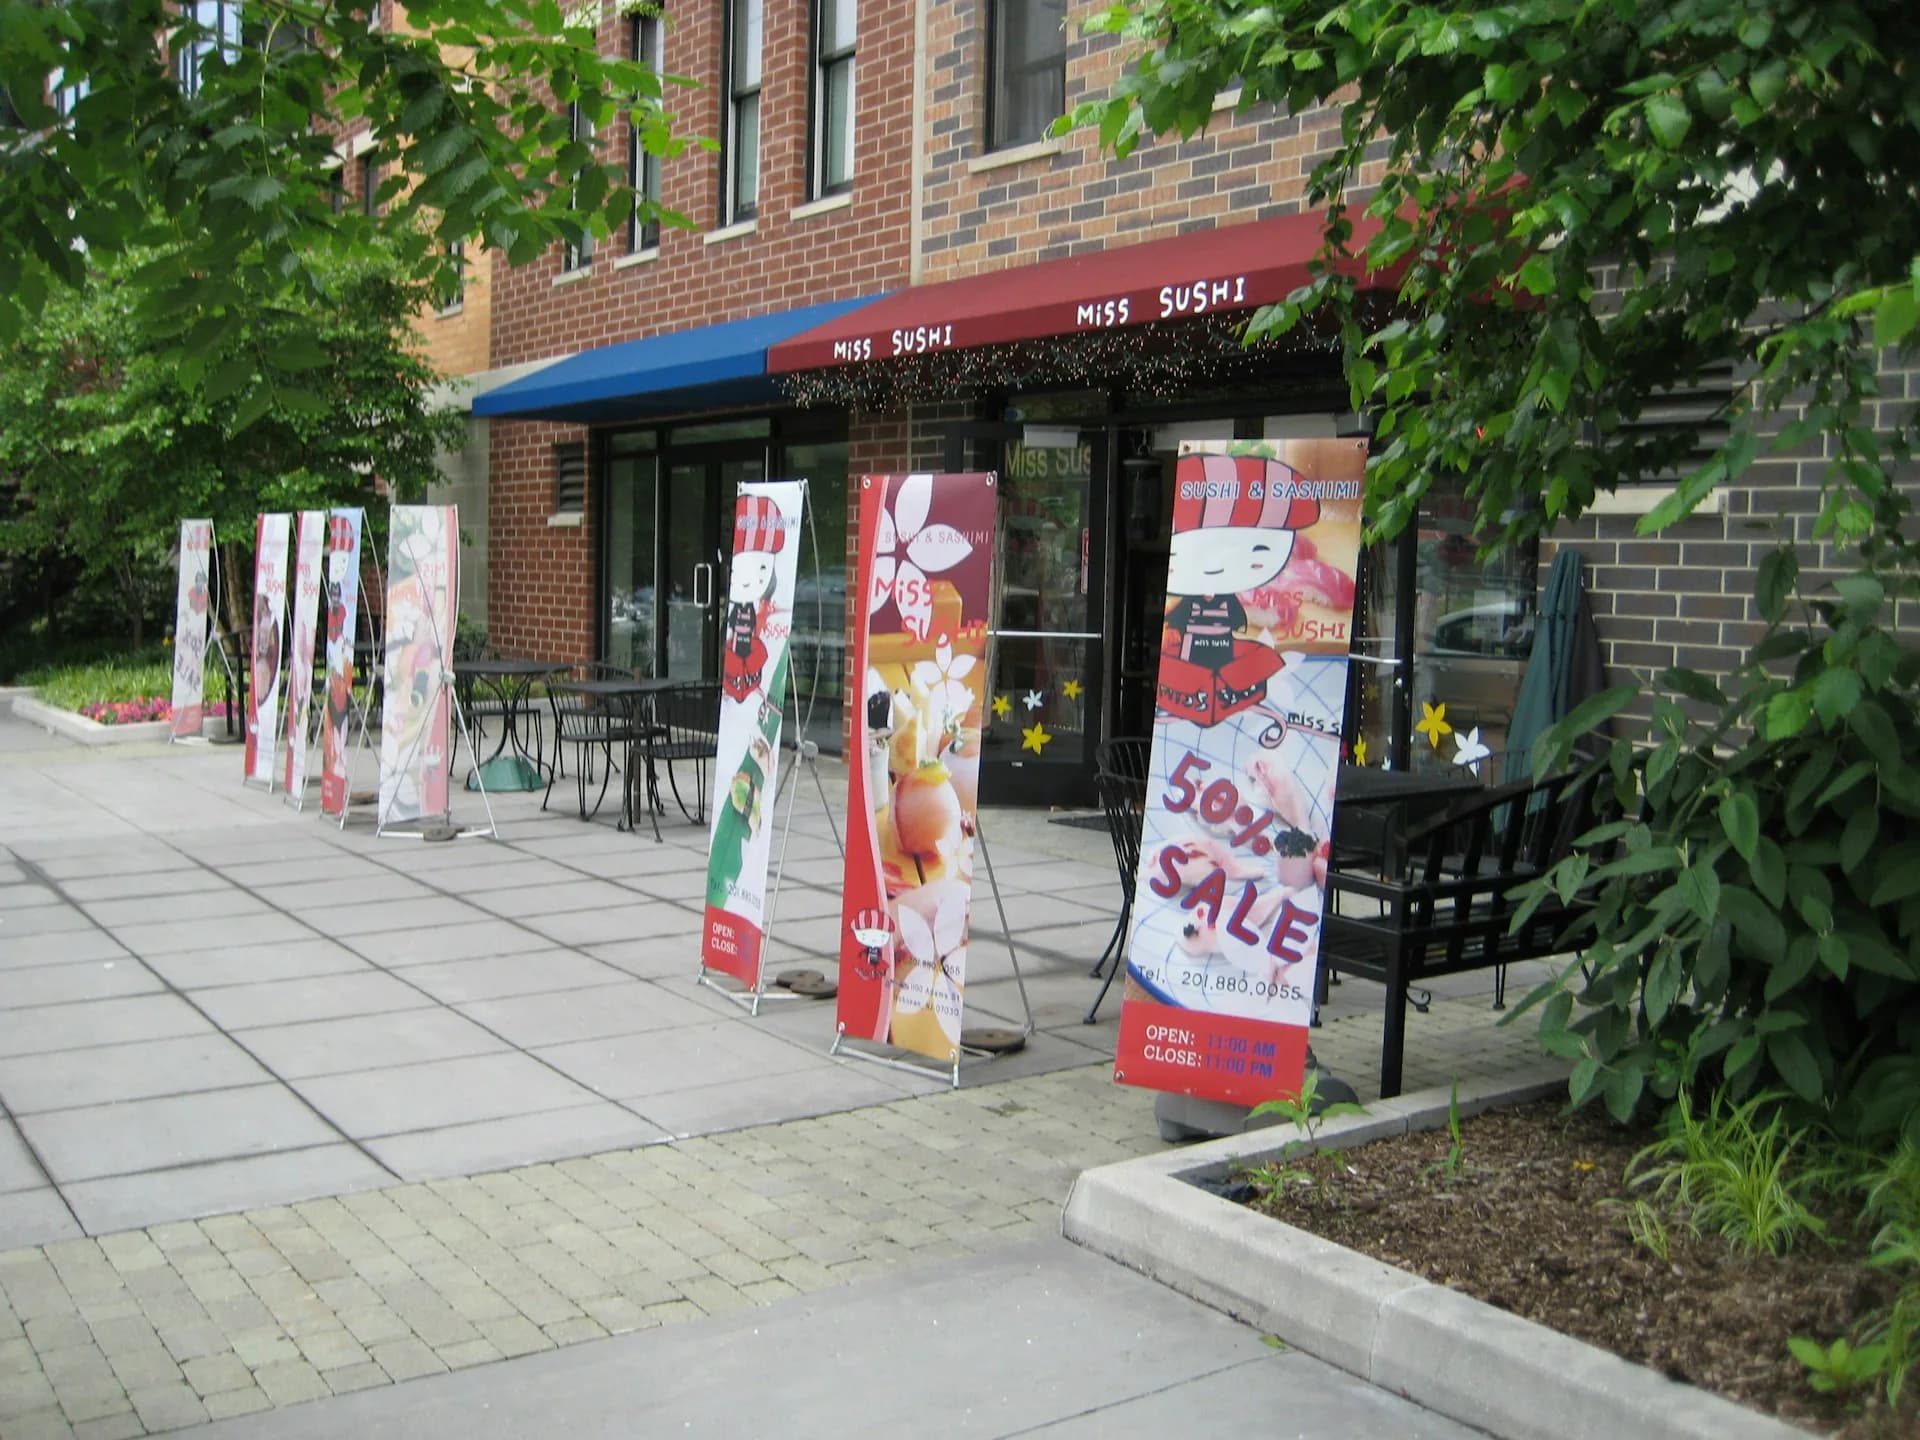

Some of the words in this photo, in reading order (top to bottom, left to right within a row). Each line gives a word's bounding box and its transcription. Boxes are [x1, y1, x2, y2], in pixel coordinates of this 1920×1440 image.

[1158, 276, 1246, 319] SUSHI
[891, 324, 953, 354] SUSHI
[1004, 440, 1048, 478] Miss
[1180, 480, 1240, 499] SUSHI
[1249, 481, 1264, 499] &
[1271, 481, 1360, 499] SASHIMI
[884, 530, 921, 545] SUSHI
[938, 530, 990, 545] SASHIMI
[1276, 620, 1346, 643] SUSHI
[1162, 750, 1274, 857] 50%
[1149, 844, 1320, 964] SALE
[711, 937, 738, 956] CLOSE:
[712, 922, 735, 940] OPEN:
[1137, 965, 1166, 985] Tel.
[1181, 970, 1303, 1001] 201.880.0055
[1145, 1024, 1196, 1046] OPEN:
[1253, 1041, 1277, 1057] AM
[1143, 1044, 1202, 1068] CLOSE:
[1250, 1061, 1274, 1079] PM
